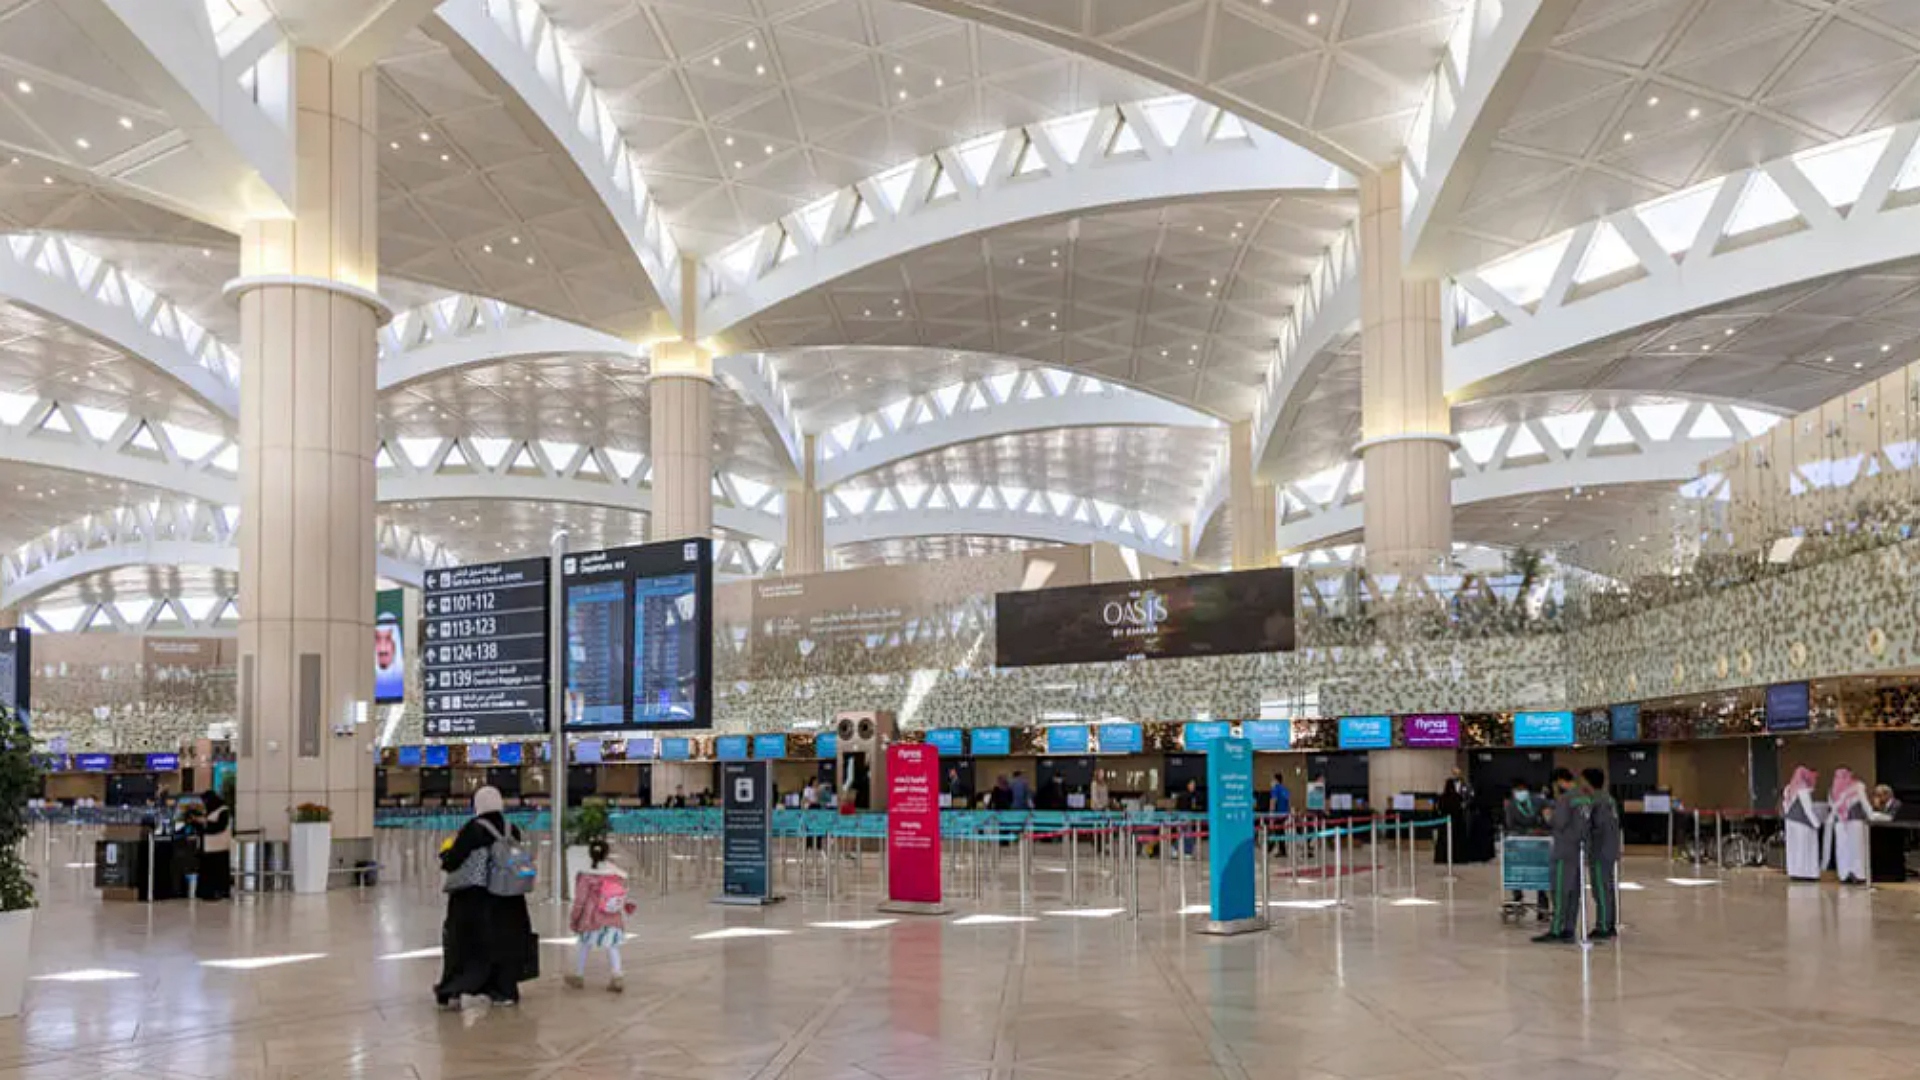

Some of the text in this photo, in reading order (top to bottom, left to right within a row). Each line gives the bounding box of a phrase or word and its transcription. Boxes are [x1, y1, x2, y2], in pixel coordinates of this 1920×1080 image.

[453, 592, 495, 612] 101-112
[1103, 597, 1168, 625] OASIS
[453, 617, 496, 637] 113-123
[453, 642, 498, 662] 124-138
[453, 669, 472, 687] 139
[1415, 718, 1448, 730] flynas
